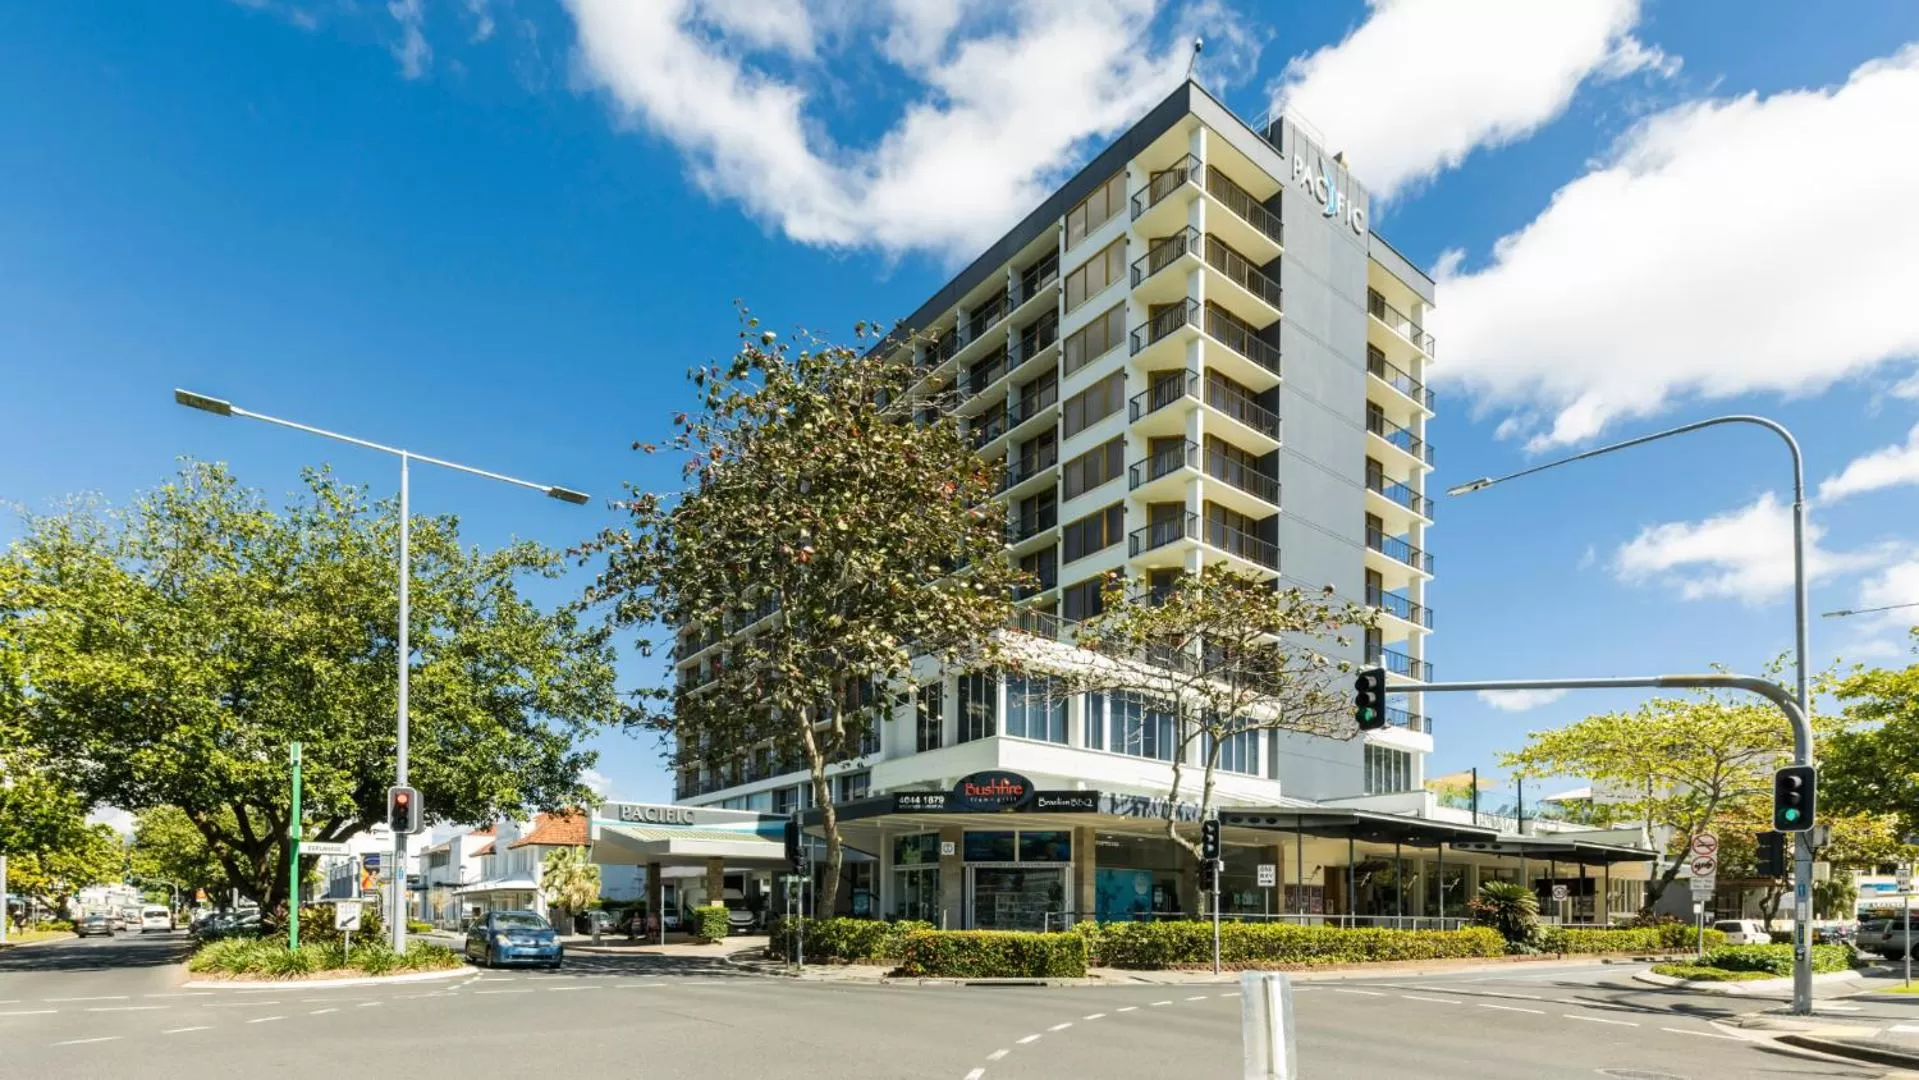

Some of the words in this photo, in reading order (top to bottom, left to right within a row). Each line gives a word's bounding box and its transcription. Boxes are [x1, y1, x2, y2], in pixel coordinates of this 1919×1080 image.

[1292, 153, 1364, 234] PACIFIC
[964, 777, 1023, 796] Bushfire
[923, 795, 945, 804] 1879
[620, 804, 695, 824] PACIFIC
